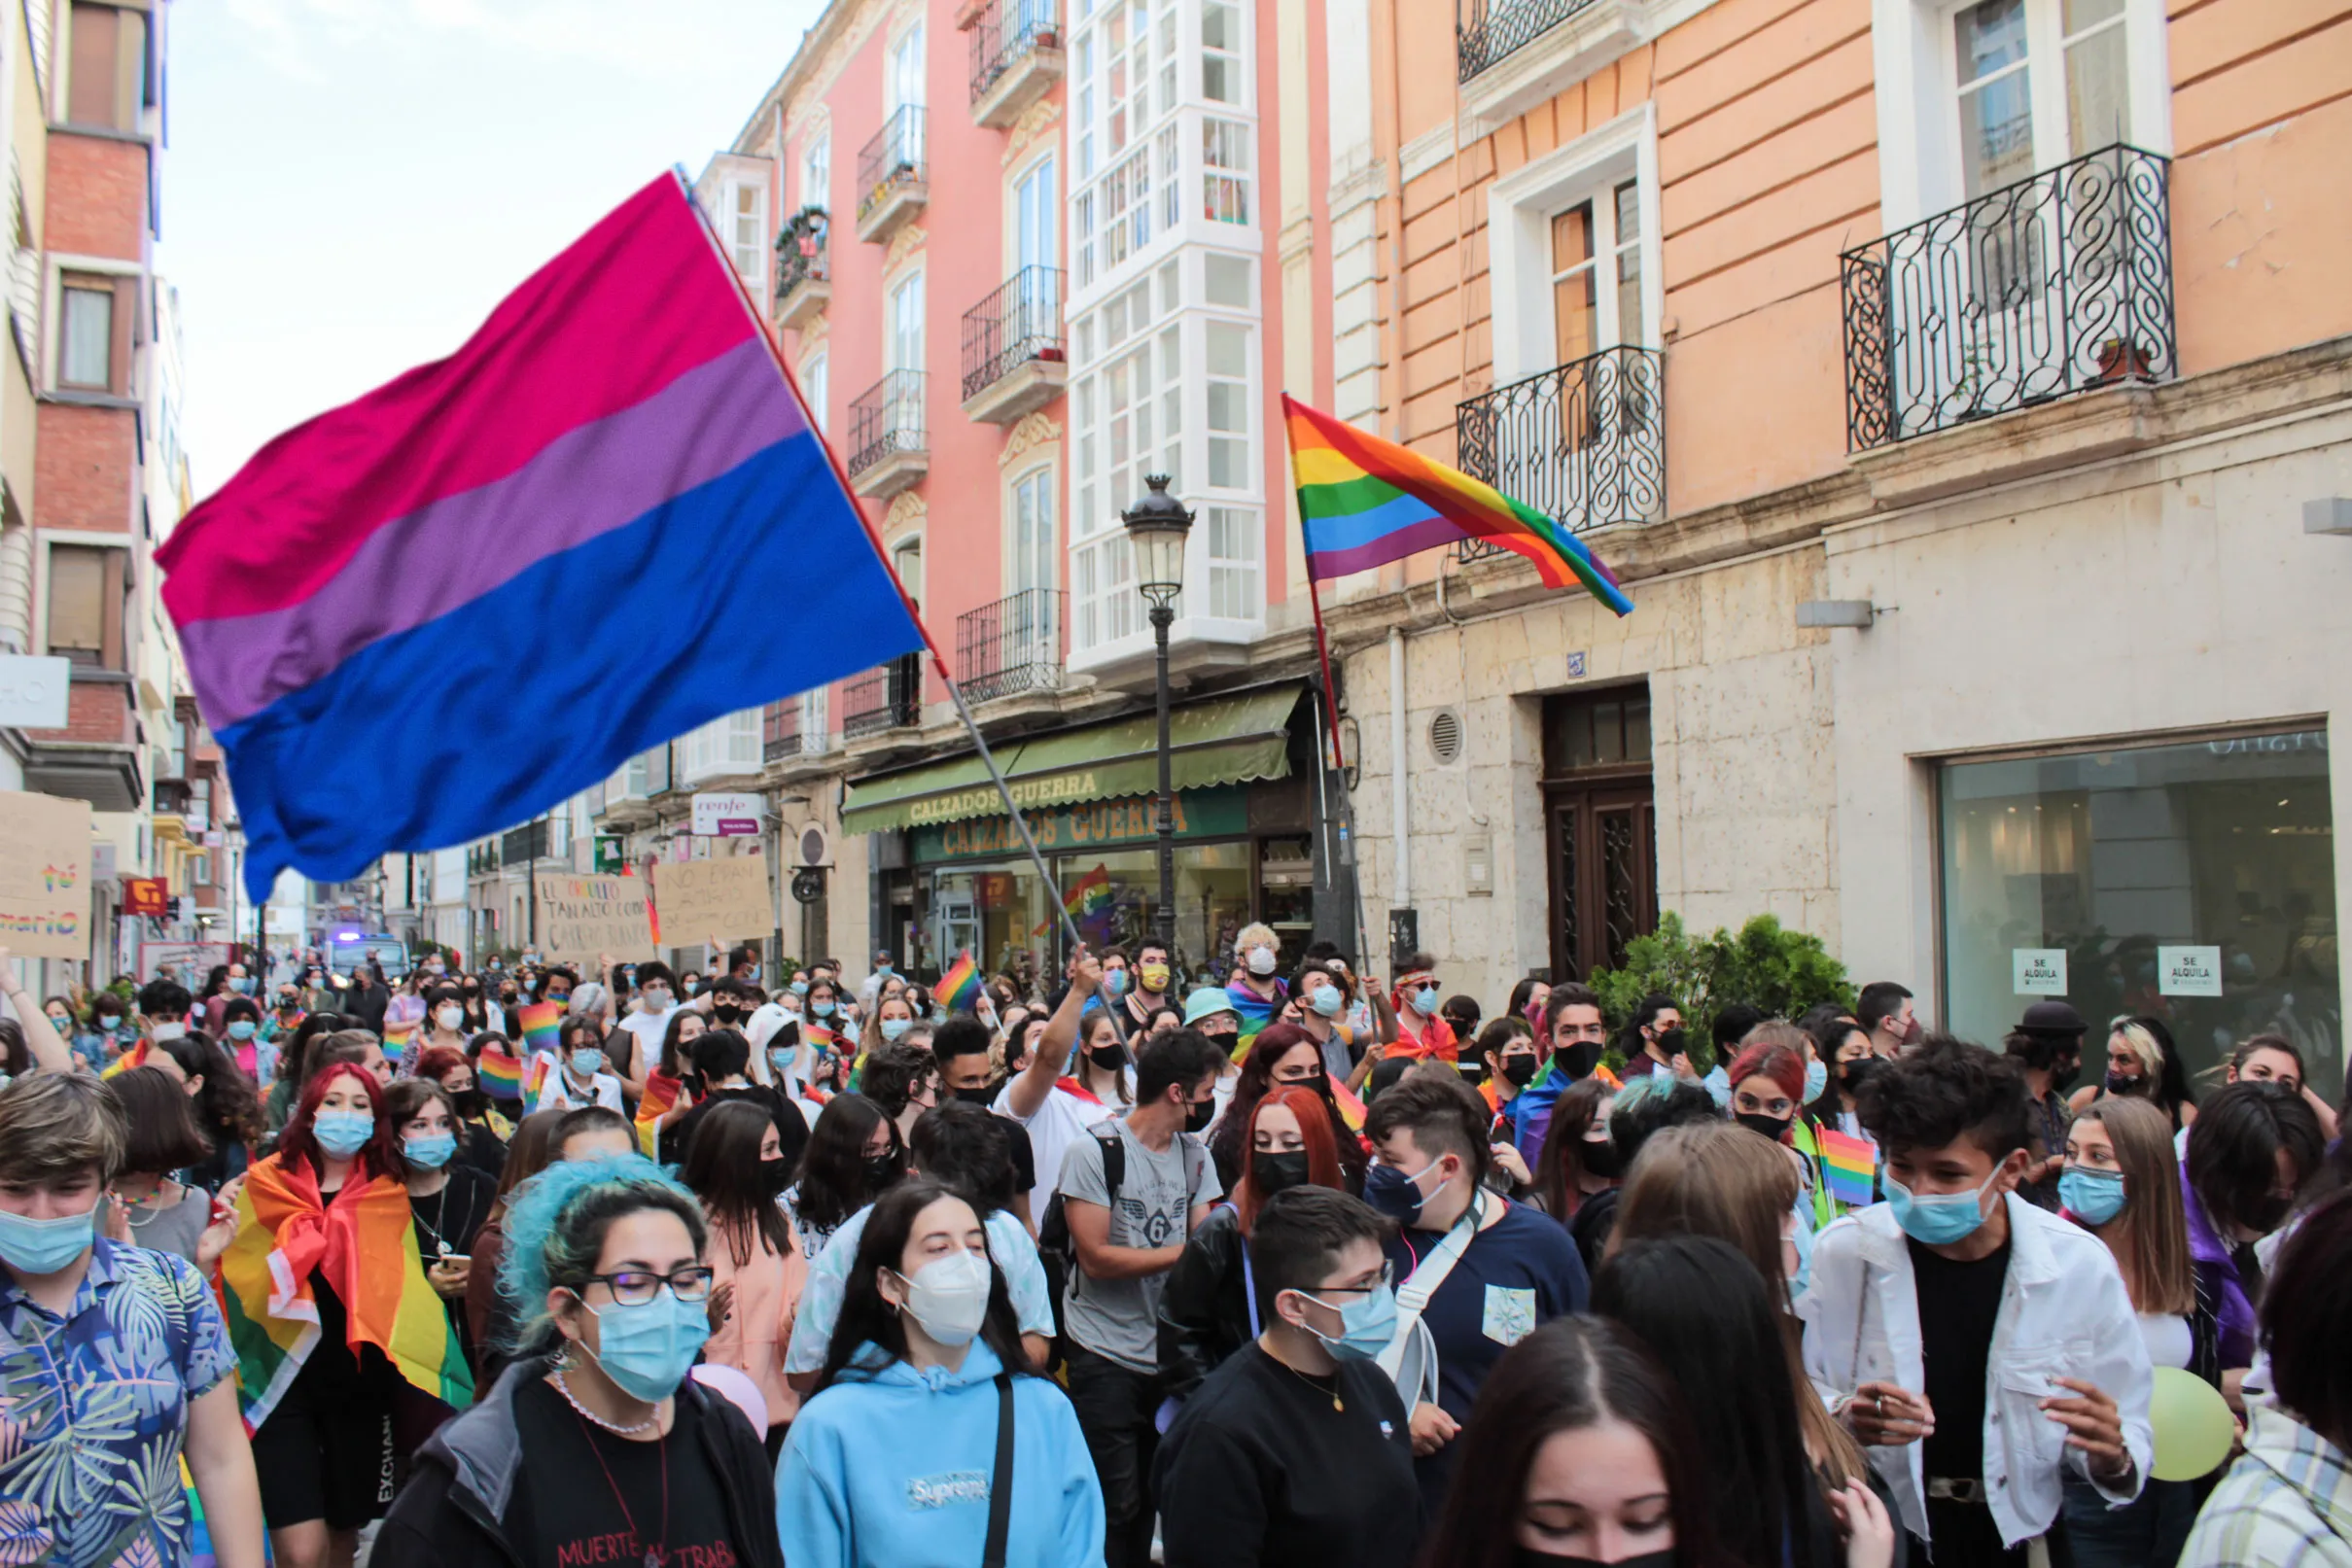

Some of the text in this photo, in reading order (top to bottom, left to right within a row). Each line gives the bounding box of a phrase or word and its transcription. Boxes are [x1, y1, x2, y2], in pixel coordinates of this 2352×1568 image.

[698, 797, 746, 815] renfe
[910, 773, 1097, 820] CALZADOS GUERRA
[943, 792, 1187, 855] CALZADOS GUERRA
[665, 868, 695, 891] NO
[542, 880, 558, 900] EL
[544, 900, 579, 920] TAN
[581, 901, 612, 920] ALTO
[2033, 958, 2047, 967] SE
[2183, 957, 2197, 966] SE
[2024, 969, 2057, 979] ALQUILA
[2171, 967, 2210, 978] ALQUILA
[1149, 1215, 1166, 1243] 6
[912, 1479, 991, 1506] Supreme
[557, 1531, 642, 1568] MUERTE
